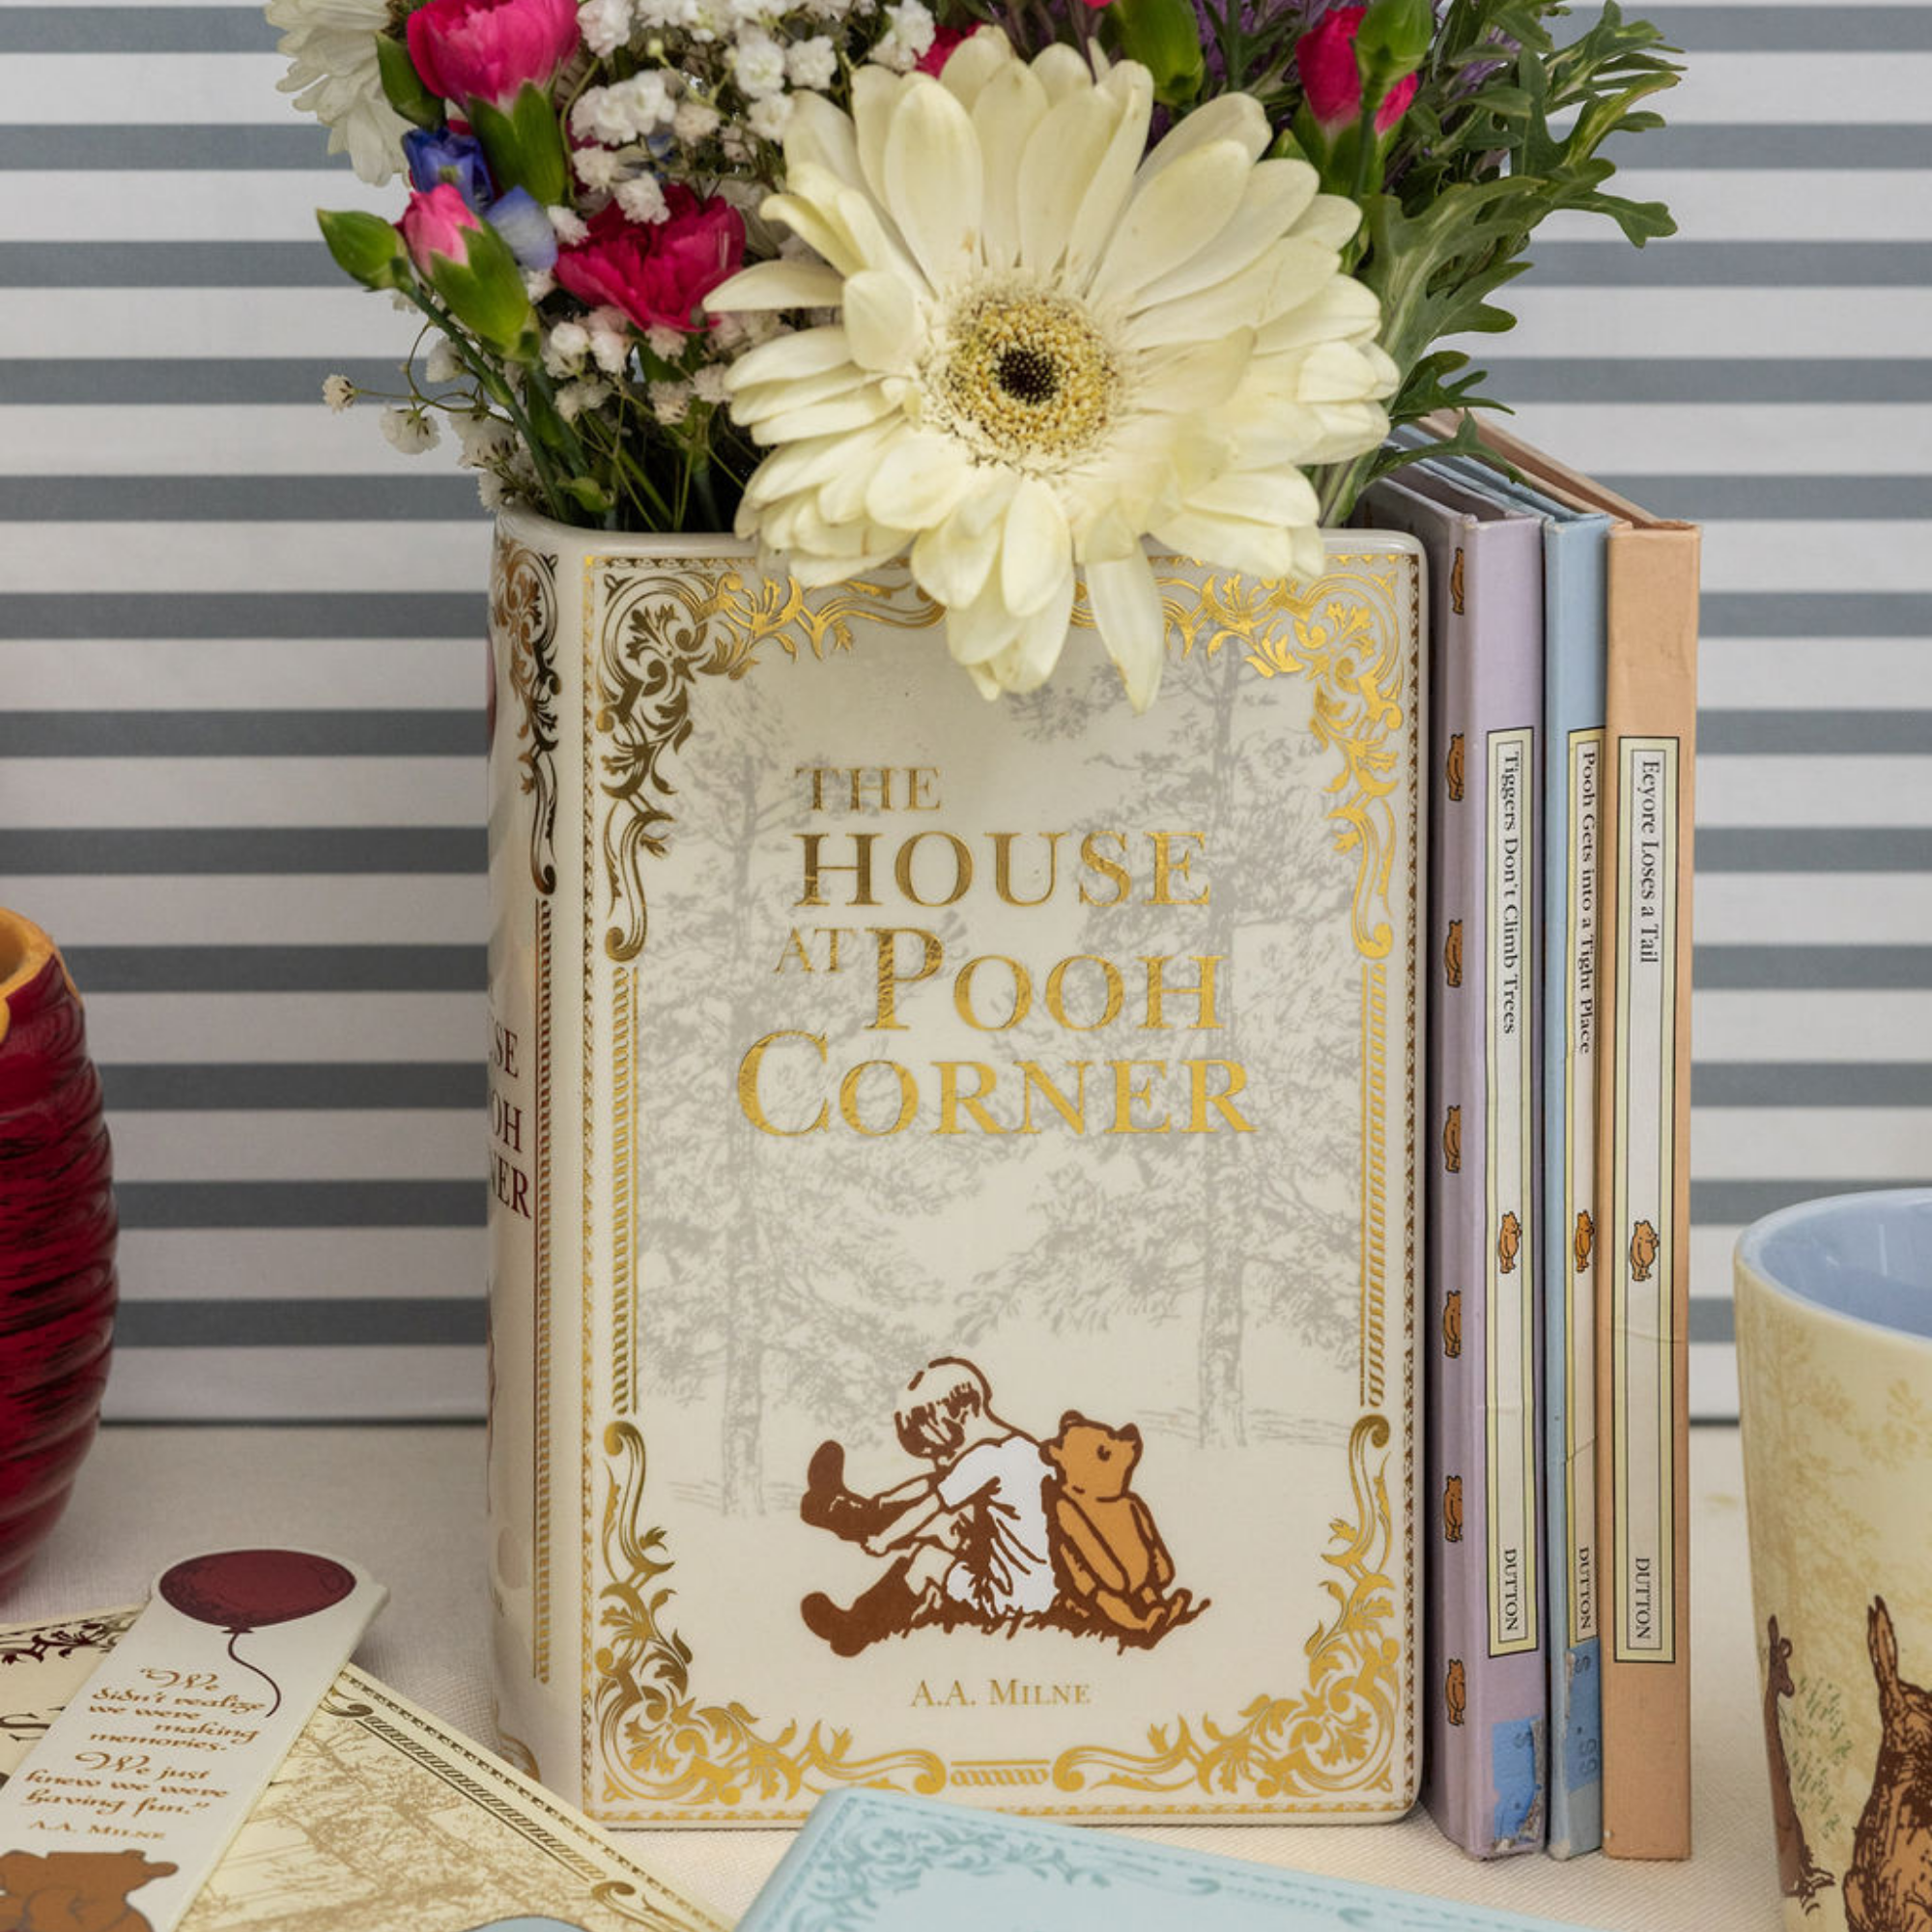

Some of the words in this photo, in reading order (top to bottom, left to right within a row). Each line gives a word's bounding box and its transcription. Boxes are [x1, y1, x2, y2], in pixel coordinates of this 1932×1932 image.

[794, 767, 941, 811] THE
[1502, 752, 1520, 831] Tiggers
[1582, 752, 1595, 808] Pooh
[1637, 760, 1661, 834] Eeyore
[1581, 813, 1595, 863] Gets
[792, 829, 1211, 907] HOUSE
[1503, 838, 1519, 896] Don't
[1581, 868, 1595, 912] into
[1641, 839, 1660, 900] Loses
[1503, 904, 1519, 969] Climb
[1581, 918, 1592, 928] a
[1640, 905, 1654, 917] a
[1578, 934, 1594, 991] Tight
[1640, 923, 1660, 963] Tail
[774, 926, 855, 973] AT
[864, 926, 1227, 1033] POOH
[1503, 974, 1518, 1035] Trees
[1579, 998, 1594, 1054] Place
[737, 1030, 1259, 1137] CORNER
[1505, 1548, 1518, 1631] DUTTON
[1579, 1548, 1591, 1630] DUTTON
[1635, 1557, 1651, 1639] DUTTON
[89, 1705, 126, 1715] we
[135, 1708, 201, 1720] were
[174, 1694, 266, 1715] realize
[909, 1679, 978, 1708] A.A.
[987, 1679, 1092, 1707] MILNE
[90, 1733, 227, 1751] memories.
[155, 1722, 261, 1745] making
[25, 1769, 100, 1787] knew
[111, 1781, 150, 1790] we
[160, 1785, 228, 1798] were
[75, 1750, 151, 1776] We
[156, 1767, 211, 1780] just
[20, 1789, 126, 1815] having
